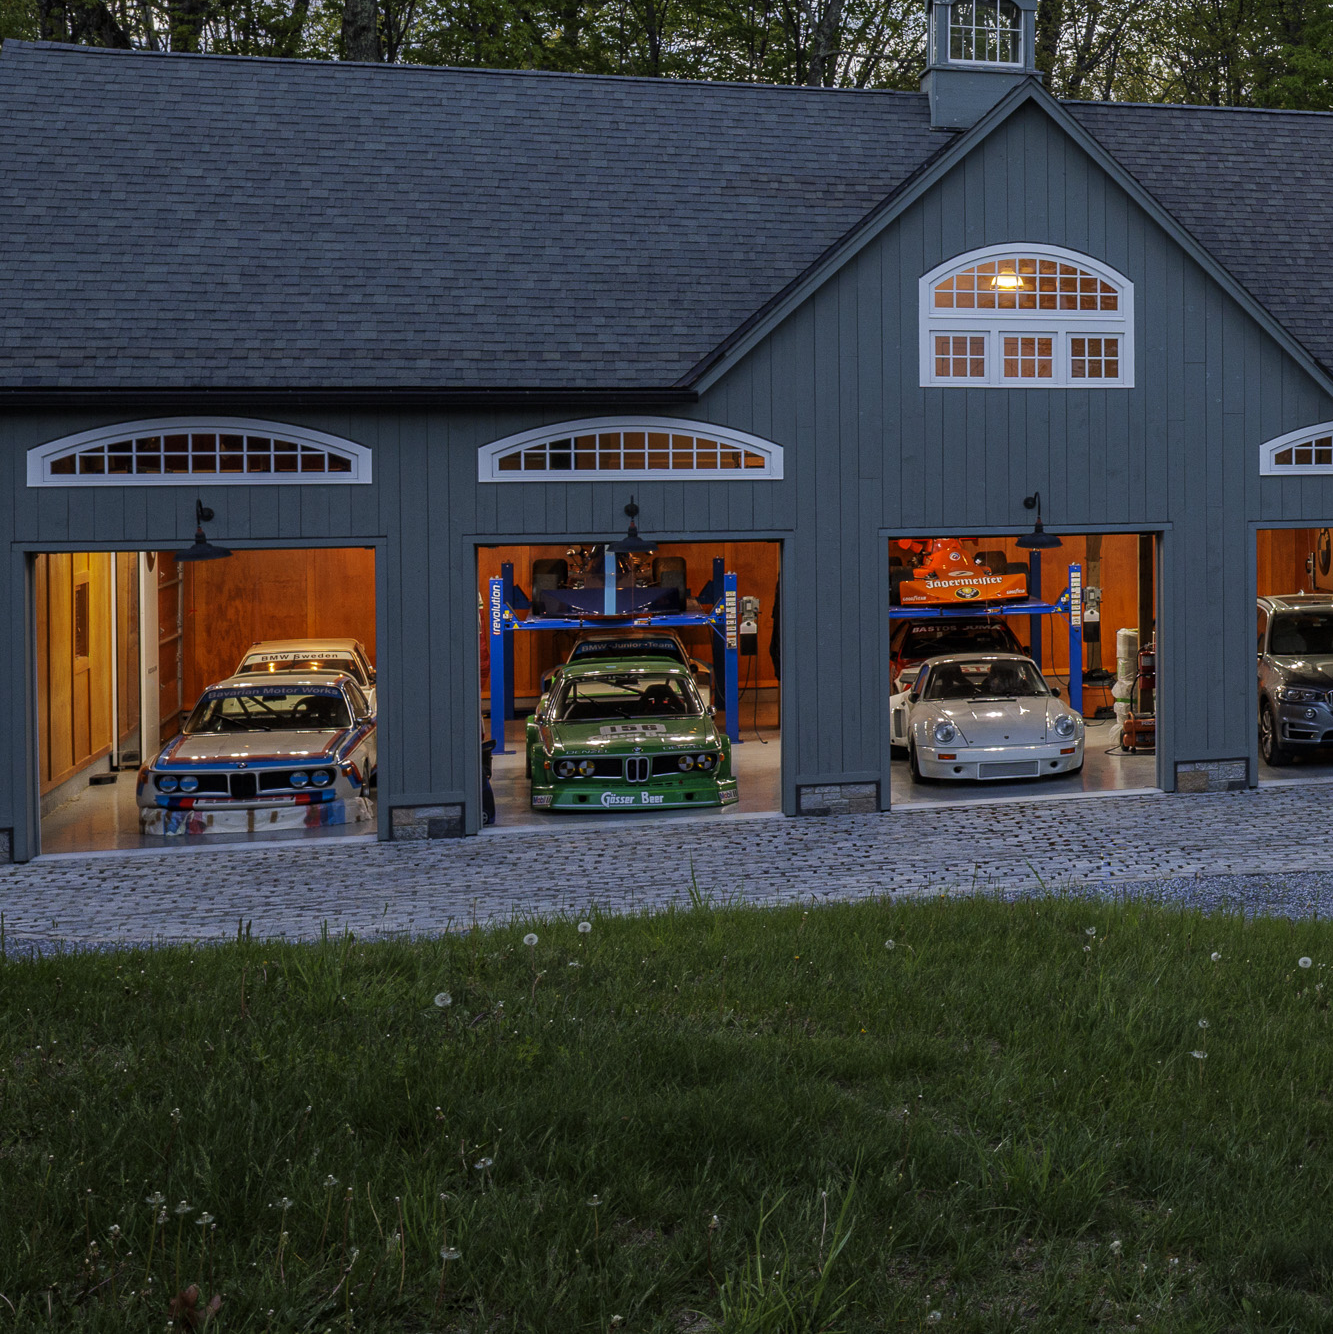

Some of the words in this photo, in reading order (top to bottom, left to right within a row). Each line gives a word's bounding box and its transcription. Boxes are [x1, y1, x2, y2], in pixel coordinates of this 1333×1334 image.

[912, 625, 957, 634] BASTOS
[581, 644, 606, 652] BMW
[261, 654, 289, 662] BMW
[208, 688, 260, 699] Bavarian
[263, 687, 298, 695] Motor
[302, 687, 339, 696] Works
[601, 791, 635, 808] Gösser
[641, 791, 664, 804] Beer
